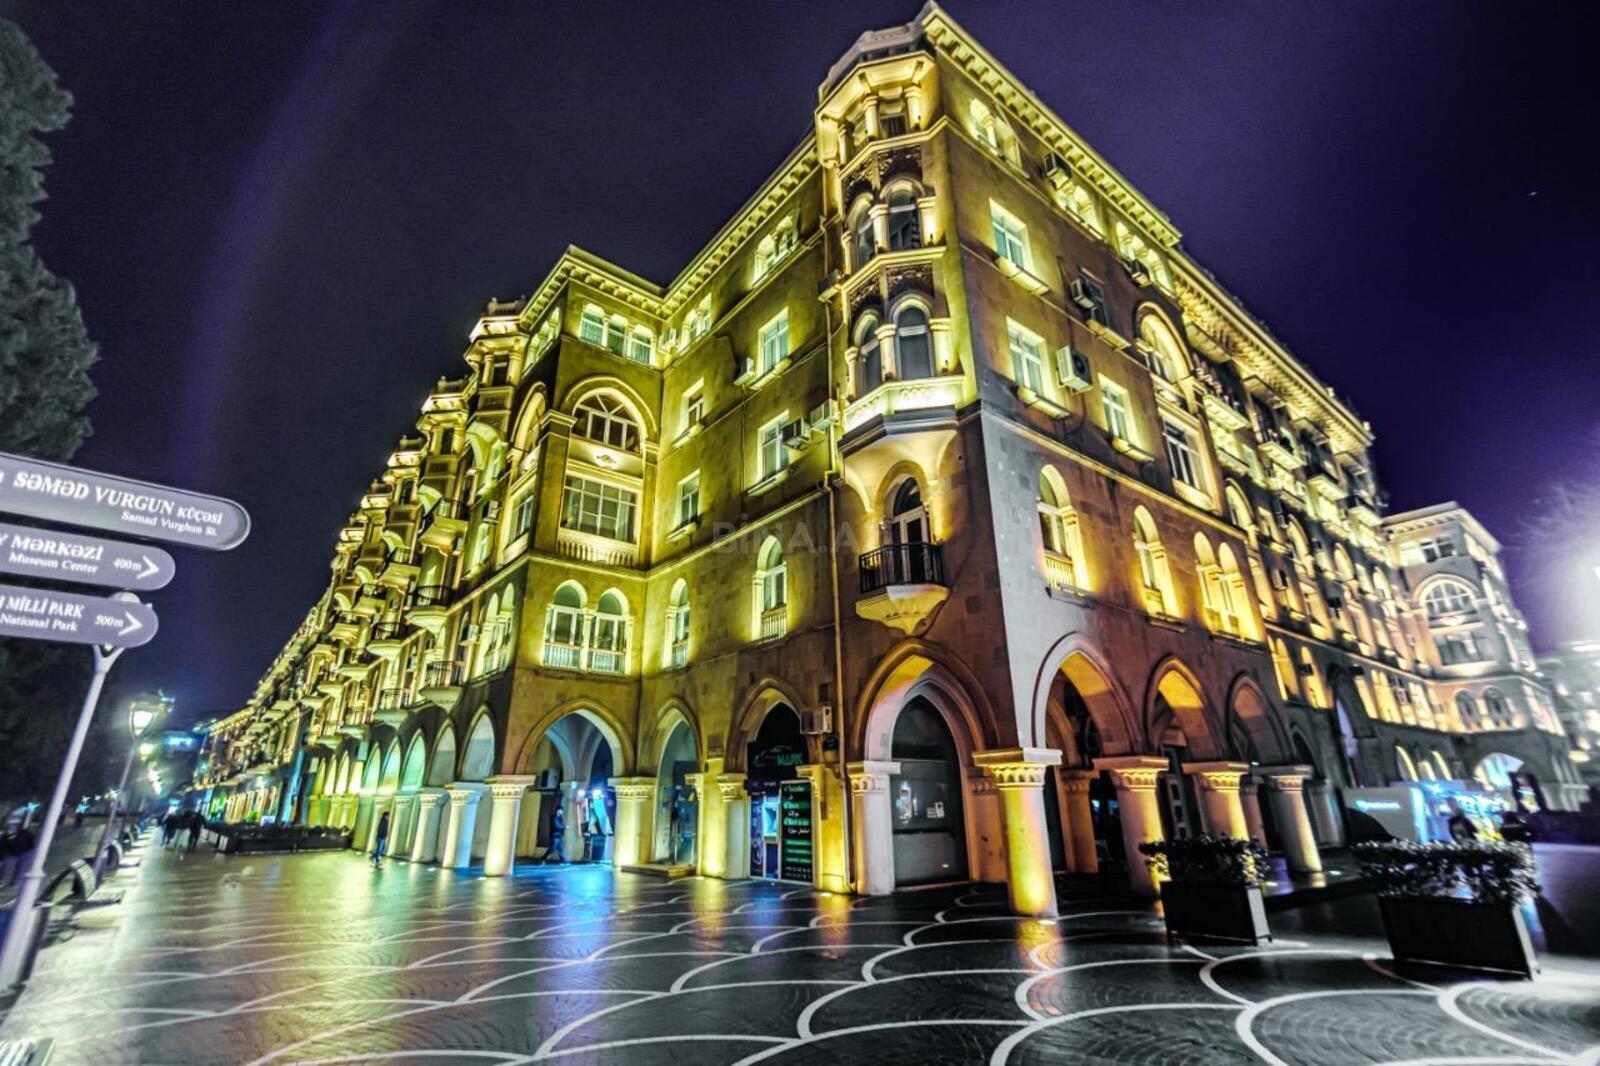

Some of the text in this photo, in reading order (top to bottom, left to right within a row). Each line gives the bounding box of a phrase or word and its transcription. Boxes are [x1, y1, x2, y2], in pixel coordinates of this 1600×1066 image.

[13, 471, 90, 500] SƏMƏD
[94, 486, 175, 516] VURGUN
[121, 511, 218, 537] Samad Vurghun St.
[10, 534, 104, 561] MƏRKƏZİ
[8, 553, 98, 574] Museum Center
[6, 595, 49, 616] MİLLİ
[48, 601, 85, 619] PARK
[0, 613, 79, 632] National Park
